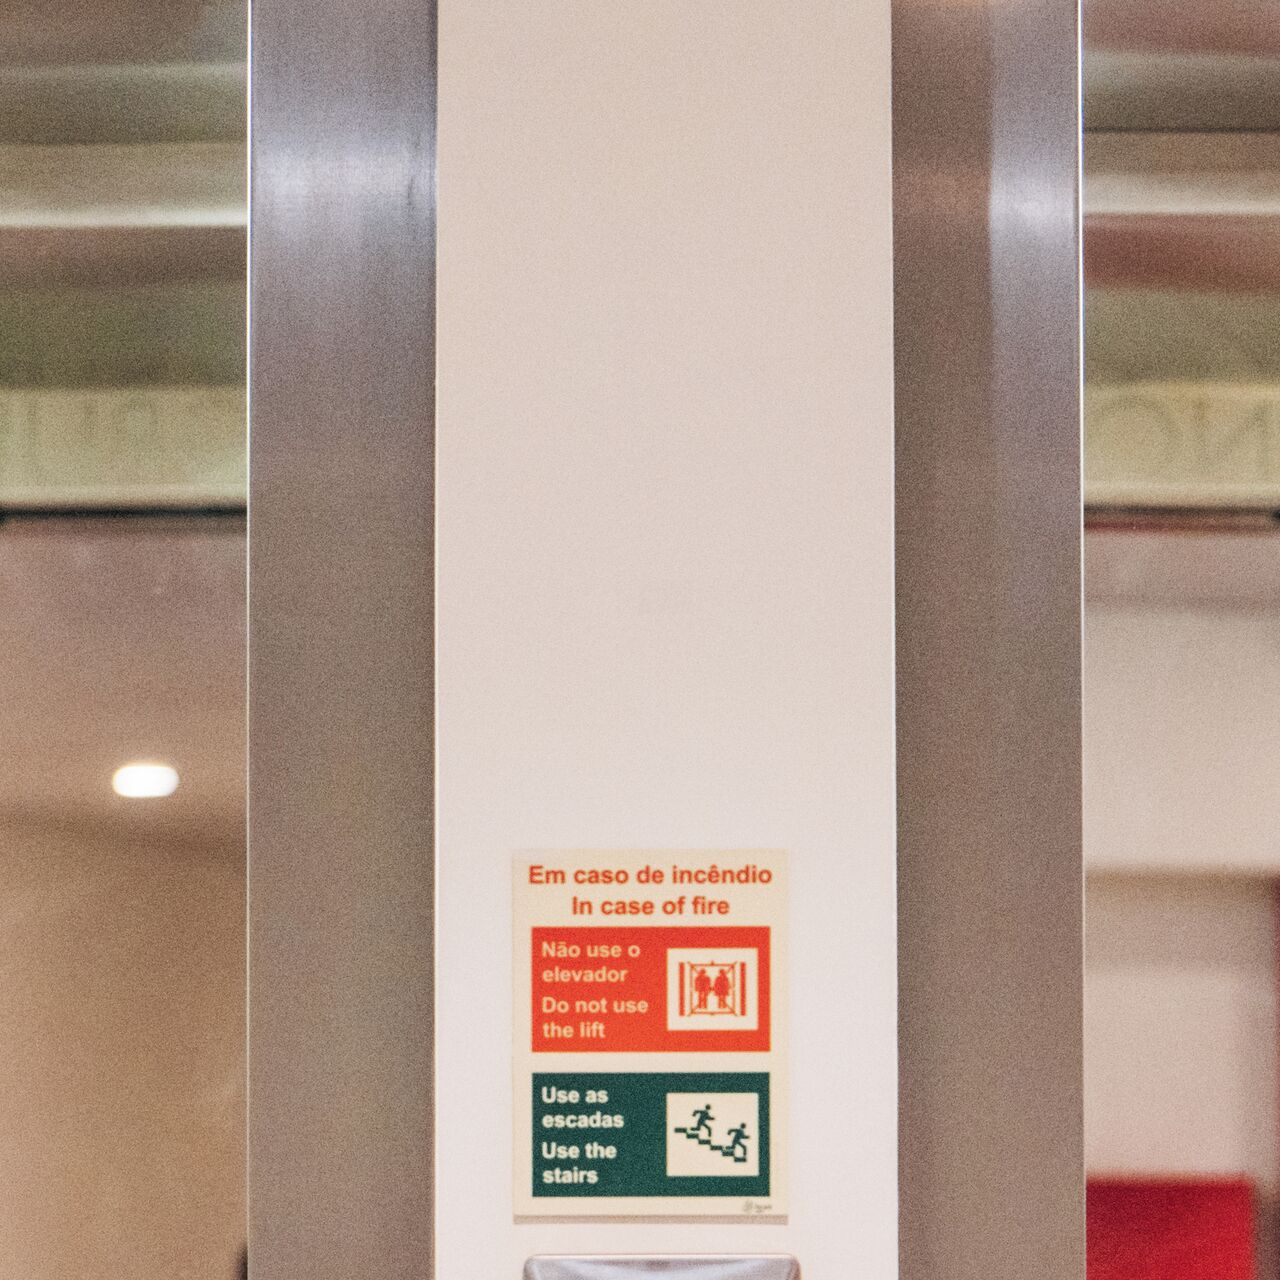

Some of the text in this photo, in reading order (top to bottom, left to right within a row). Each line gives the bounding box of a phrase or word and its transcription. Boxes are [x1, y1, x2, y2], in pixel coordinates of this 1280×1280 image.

[528, 864, 773, 885] Em caso de incêndio
[572, 895, 730, 916] In case of fire
[541, 941, 641, 958] Não use o
[542, 965, 629, 983] elevador
[541, 996, 649, 1014] Do not use
[542, 1021, 606, 1039] the lift
[541, 1086, 609, 1104] Use as
[541, 1110, 625, 1129] escadas
[541, 1141, 618, 1160] Use the
[542, 1166, 599, 1184] stairs
